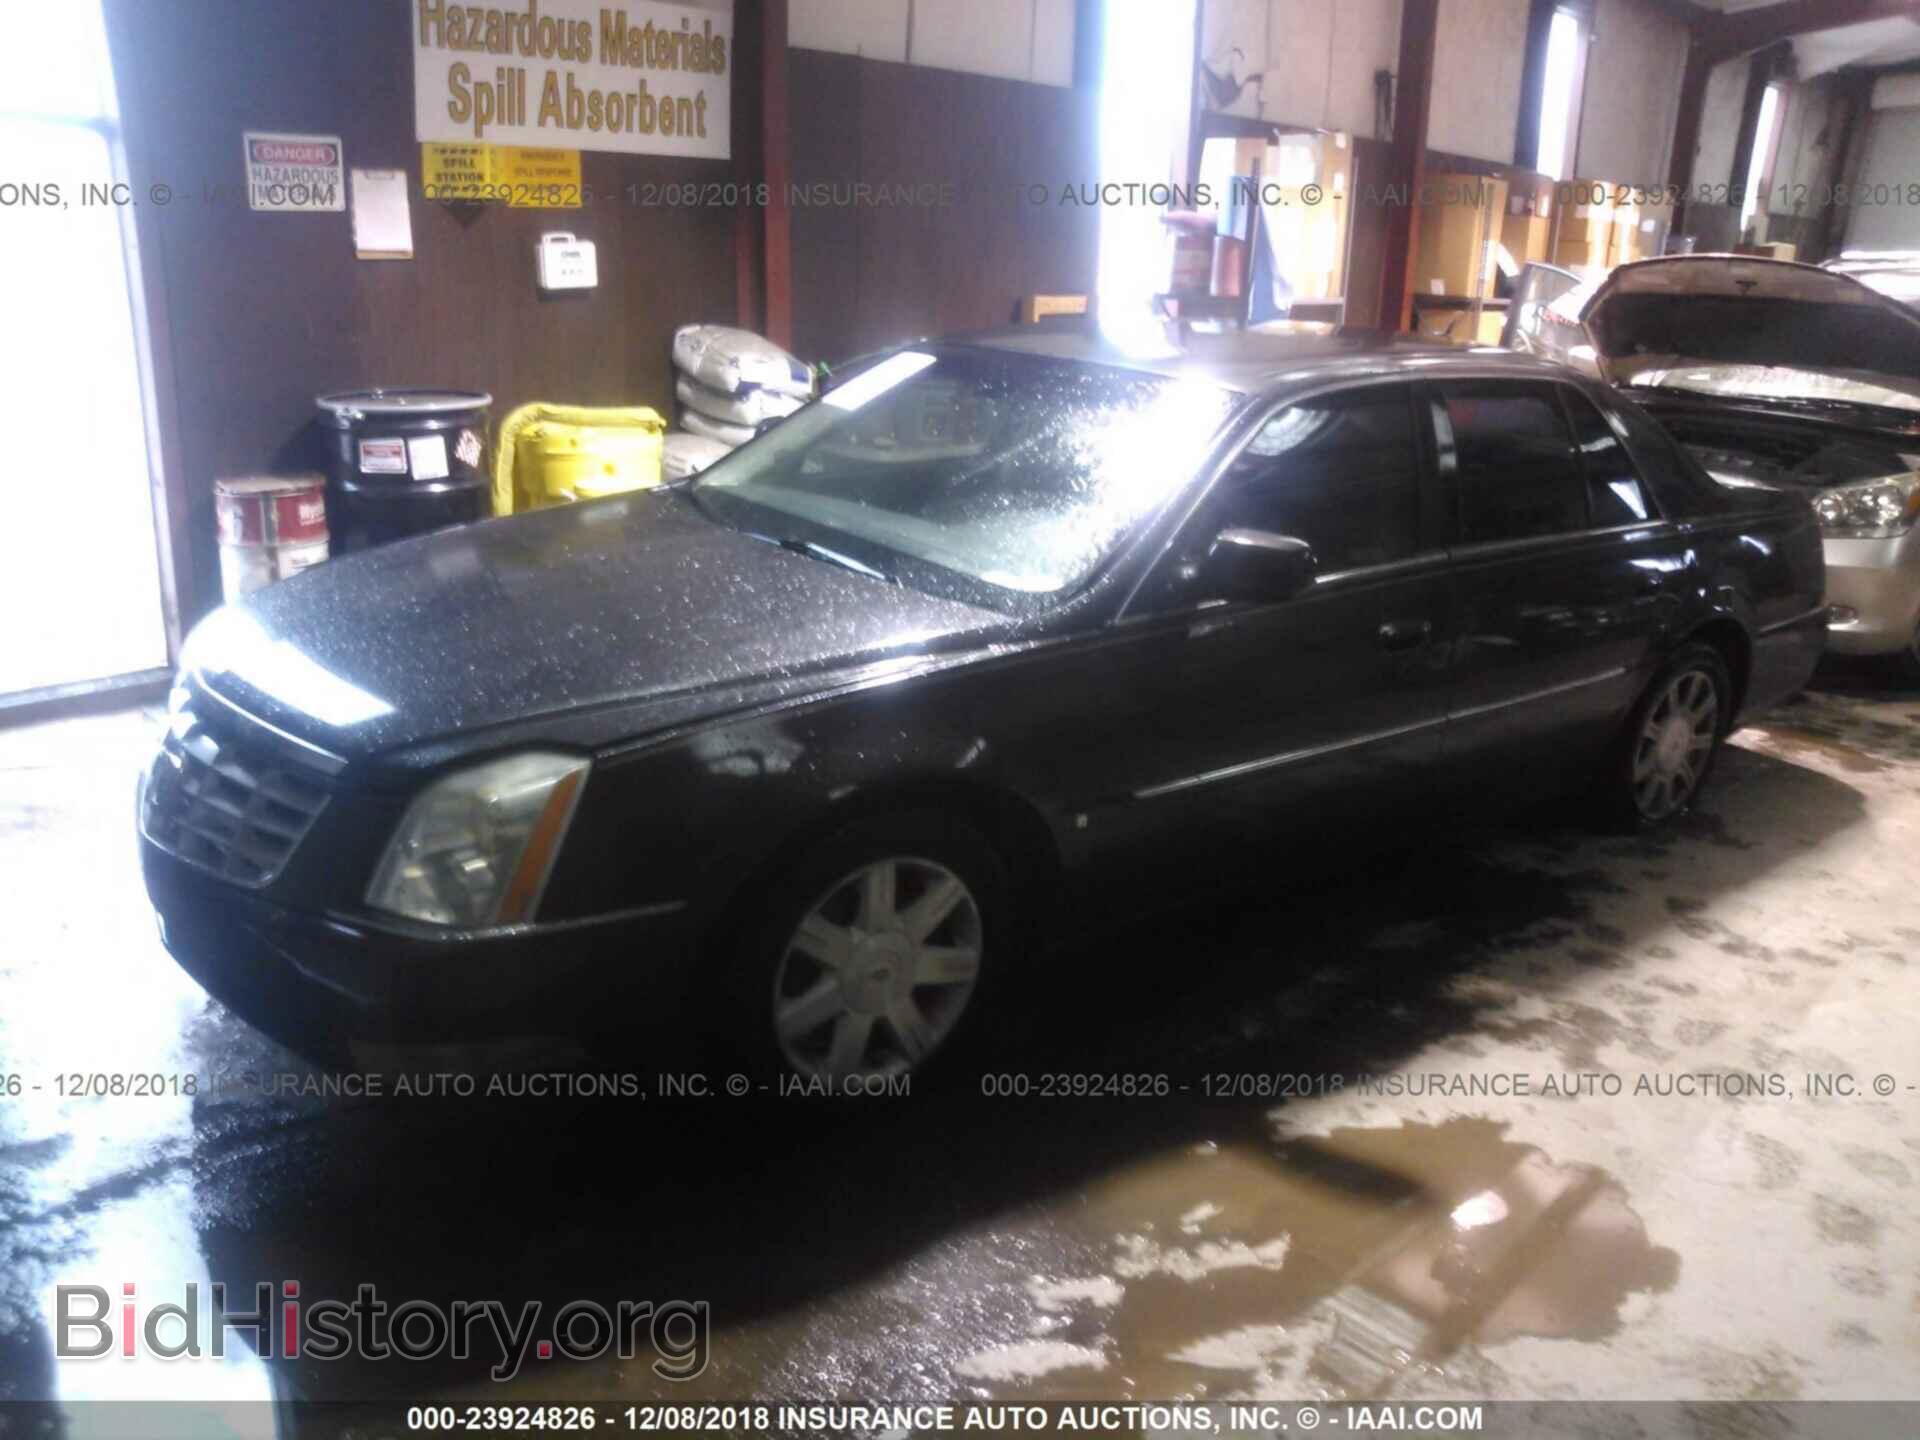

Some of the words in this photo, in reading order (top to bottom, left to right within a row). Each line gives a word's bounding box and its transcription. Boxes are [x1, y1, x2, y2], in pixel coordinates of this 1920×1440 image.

[419, 0, 593, 63] Hazardous
[600, 9, 727, 75] Materials
[448, 61, 527, 138] Spill
[538, 70, 708, 138] Absorbent
[263, 146, 326, 162] DANGER
[252, 167, 339, 185] HAZARDOUS
[435, 172, 485, 183] STATION
